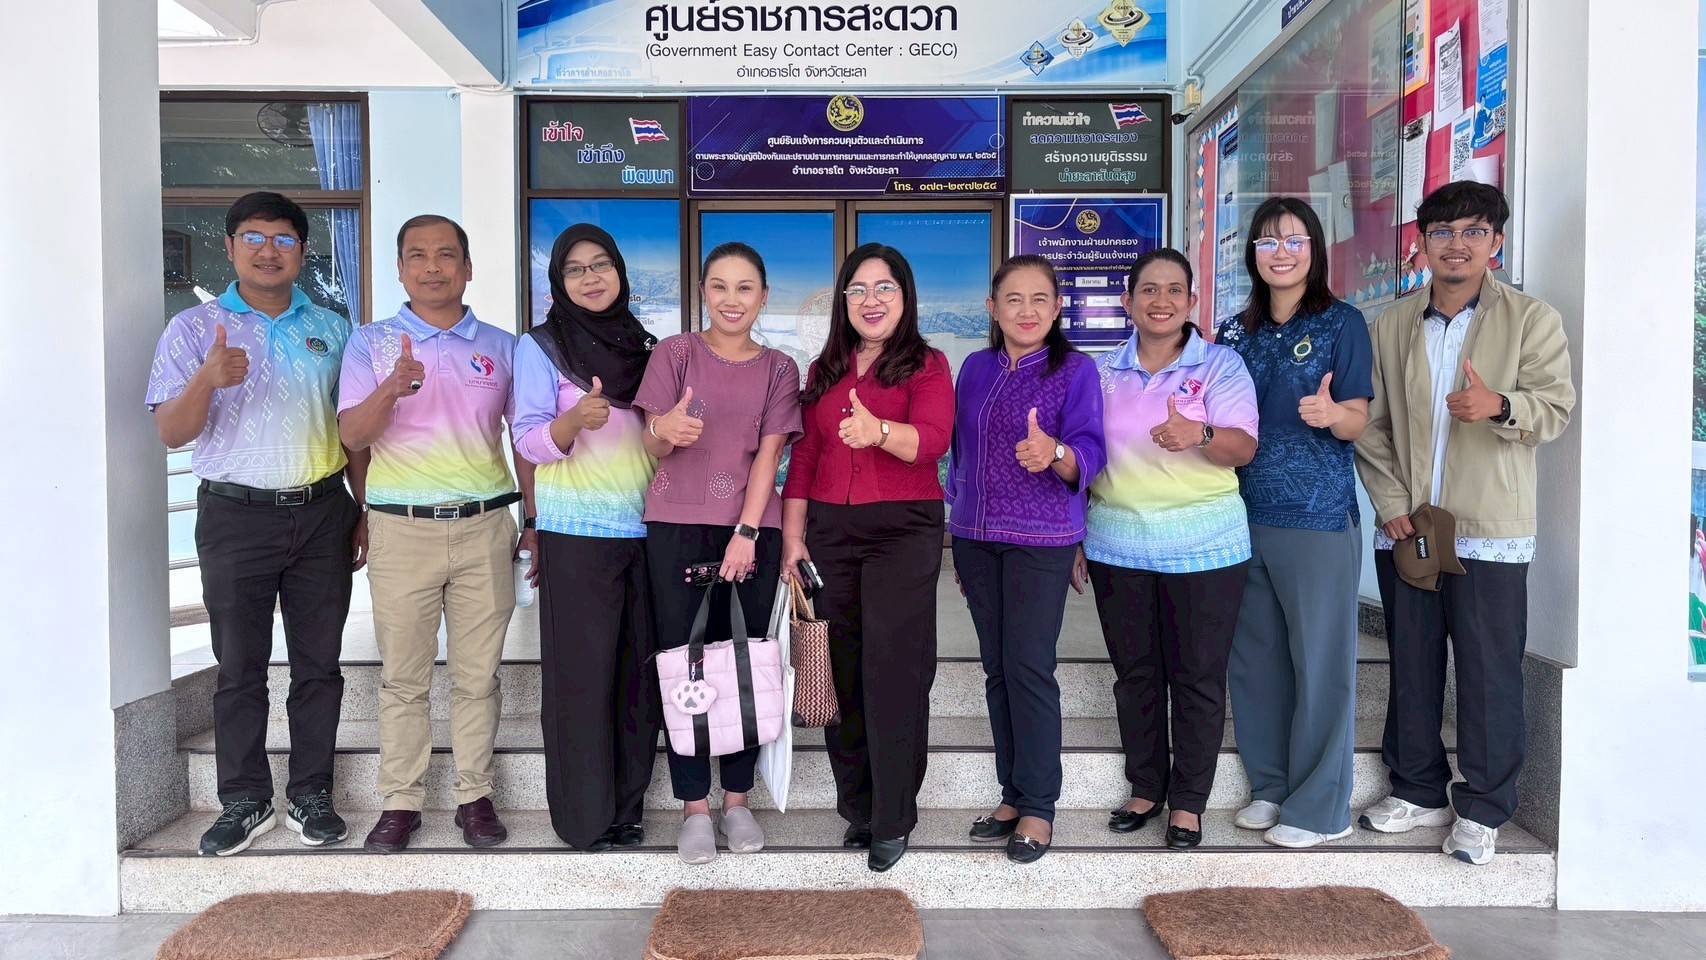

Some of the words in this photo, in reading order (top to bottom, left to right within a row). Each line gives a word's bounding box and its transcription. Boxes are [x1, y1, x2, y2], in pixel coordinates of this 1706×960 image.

[645, 0, 958, 41] ศูนย์ราชการสะดวก
[646, 43, 737, 60] (Government
[743, 43, 777, 60] Easy
[783, 43, 839, 57] Contact
[845, 43, 893, 56] Center
[899, 46, 903, 56] :
[909, 42, 958, 59] GECC)
[736, 63, 800, 77] อำเภอธารโต
[804, 65, 867, 78] จังหวัดยะลา
[1022, 111, 1091, 126] ทำความเข้าใจ
[542, 121, 584, 142] เข้าใจ
[1029, 131, 1138, 144] ลดความหวาดระแวง
[767, 134, 924, 147] ศูนย์รับแจ้งการควบคุมตัวและดำเนินการ
[577, 143, 625, 163] เข้าถึง
[1044, 150, 1148, 165] สร้างความยุติธรรม
[622, 165, 674, 184] พัฒนา
[792, 165, 844, 175] อำเภอธารโต
[849, 165, 899, 175] จังหวัดยะลา
[893, 182, 914, 191] โทร.
[1038, 236, 1138, 247] เจ้าพนักงานฝ่ายปกครอง
